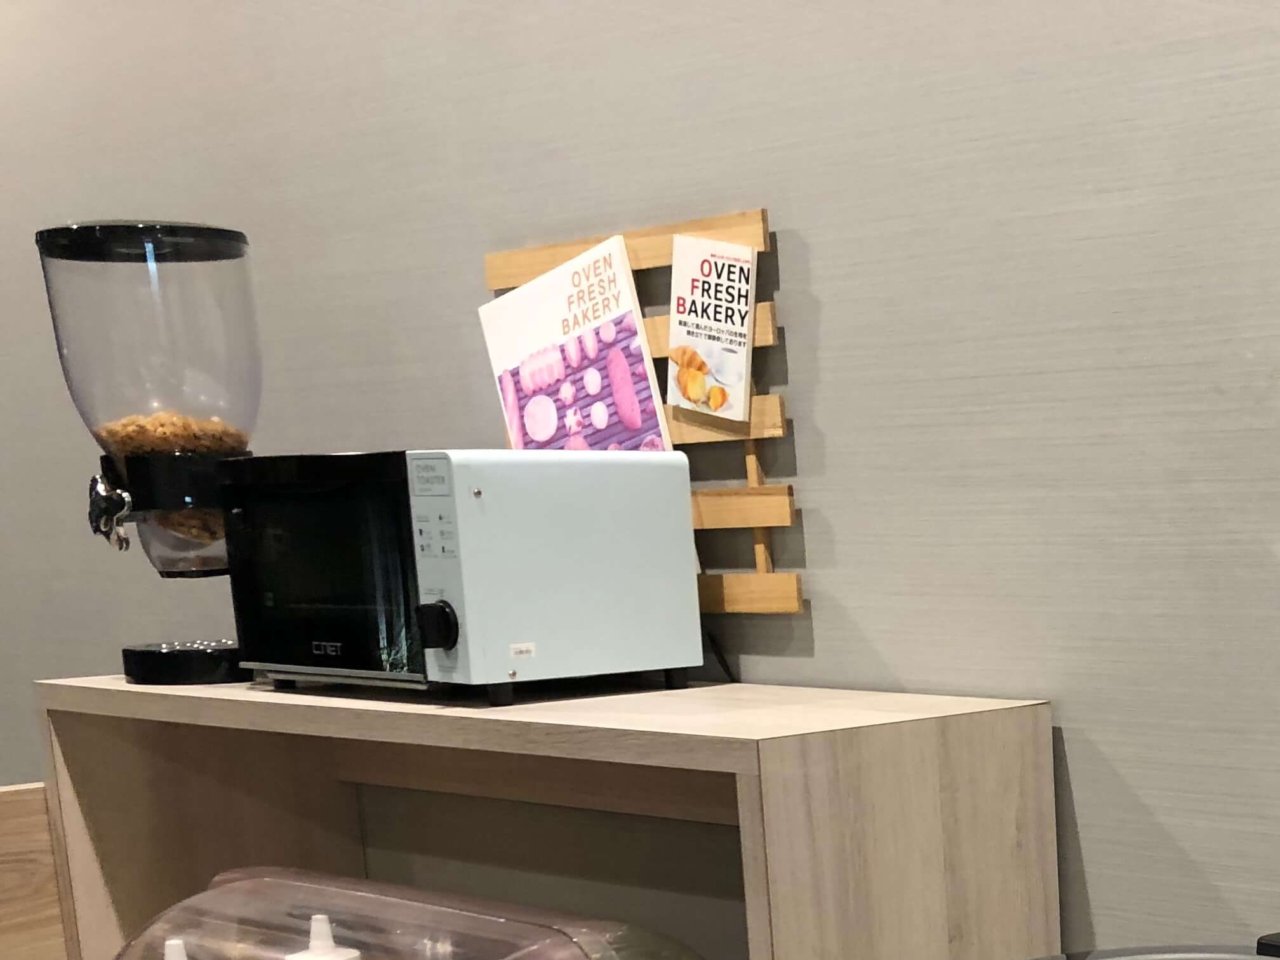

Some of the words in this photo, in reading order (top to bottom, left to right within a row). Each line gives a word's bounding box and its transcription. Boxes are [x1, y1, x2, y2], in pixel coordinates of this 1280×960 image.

[571, 253, 613, 288] OVEN
[700, 259, 751, 286] OVEN
[567, 275, 617, 313] FRESH
[690, 278, 750, 306] FRESH
[561, 291, 622, 335] BAKERY
[676, 296, 749, 328] BAKERY
